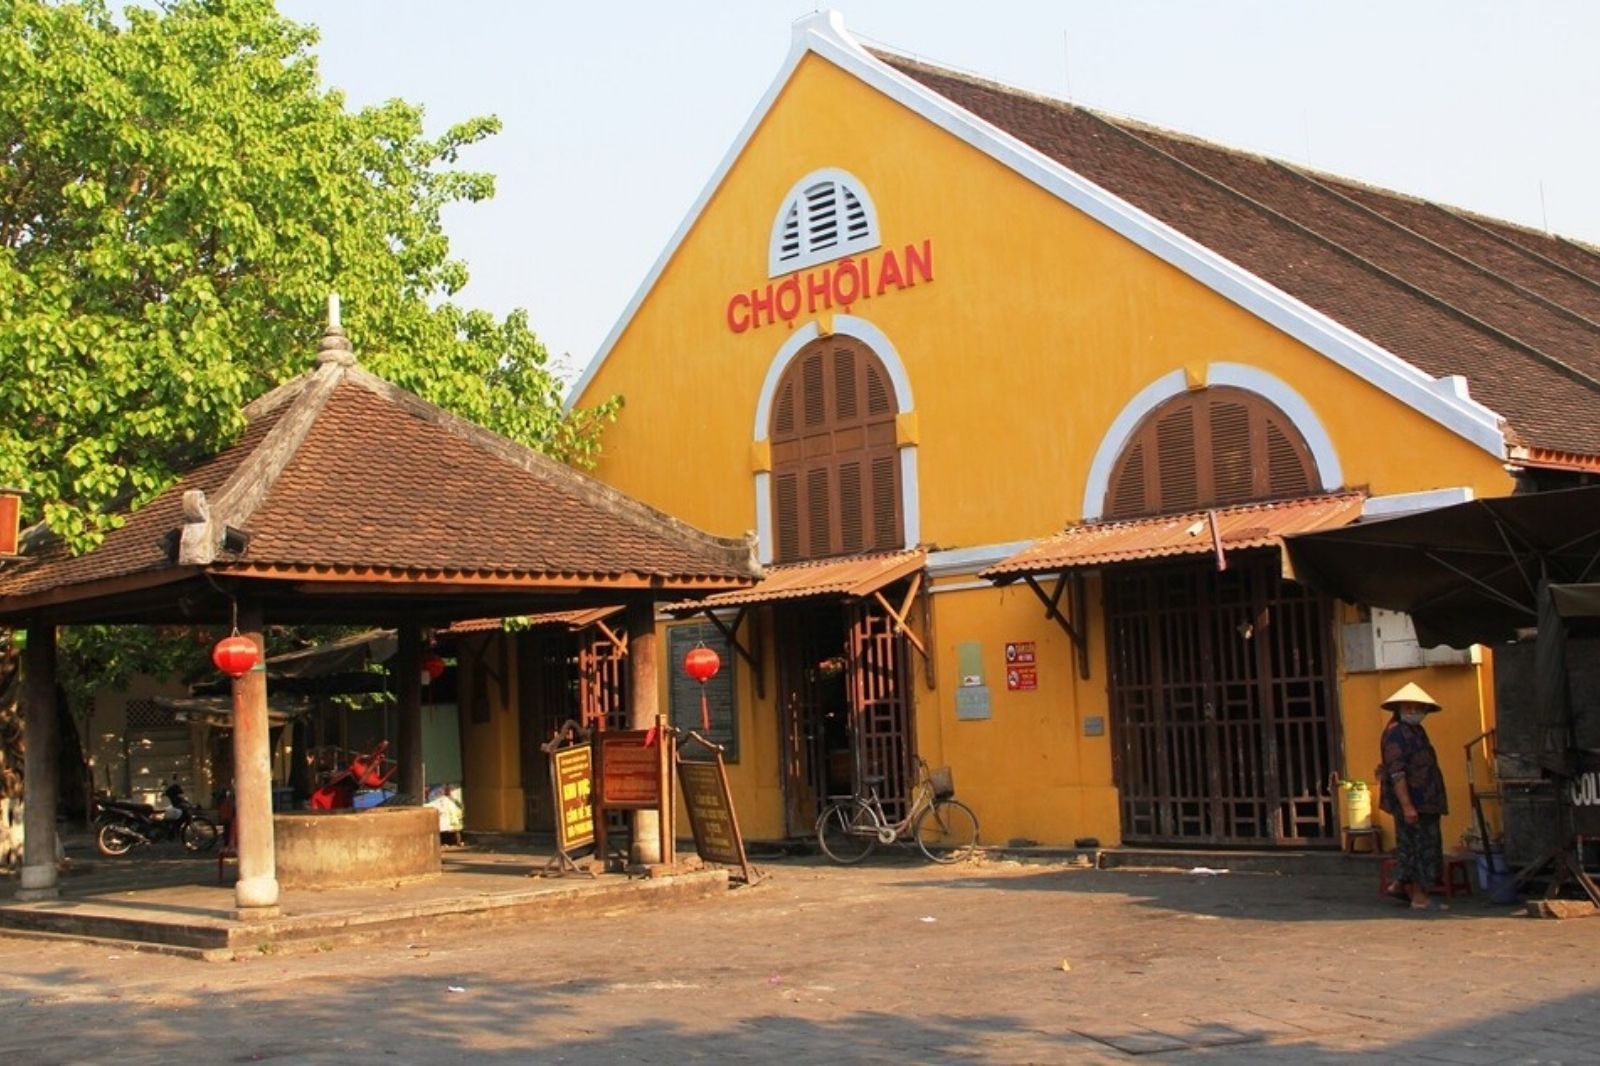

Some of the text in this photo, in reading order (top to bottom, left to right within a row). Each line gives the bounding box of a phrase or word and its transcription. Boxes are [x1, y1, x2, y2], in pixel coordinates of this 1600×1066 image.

[727, 239, 934, 333] CHỢ HỘI AN
[1570, 772, 1600, 806] COL
